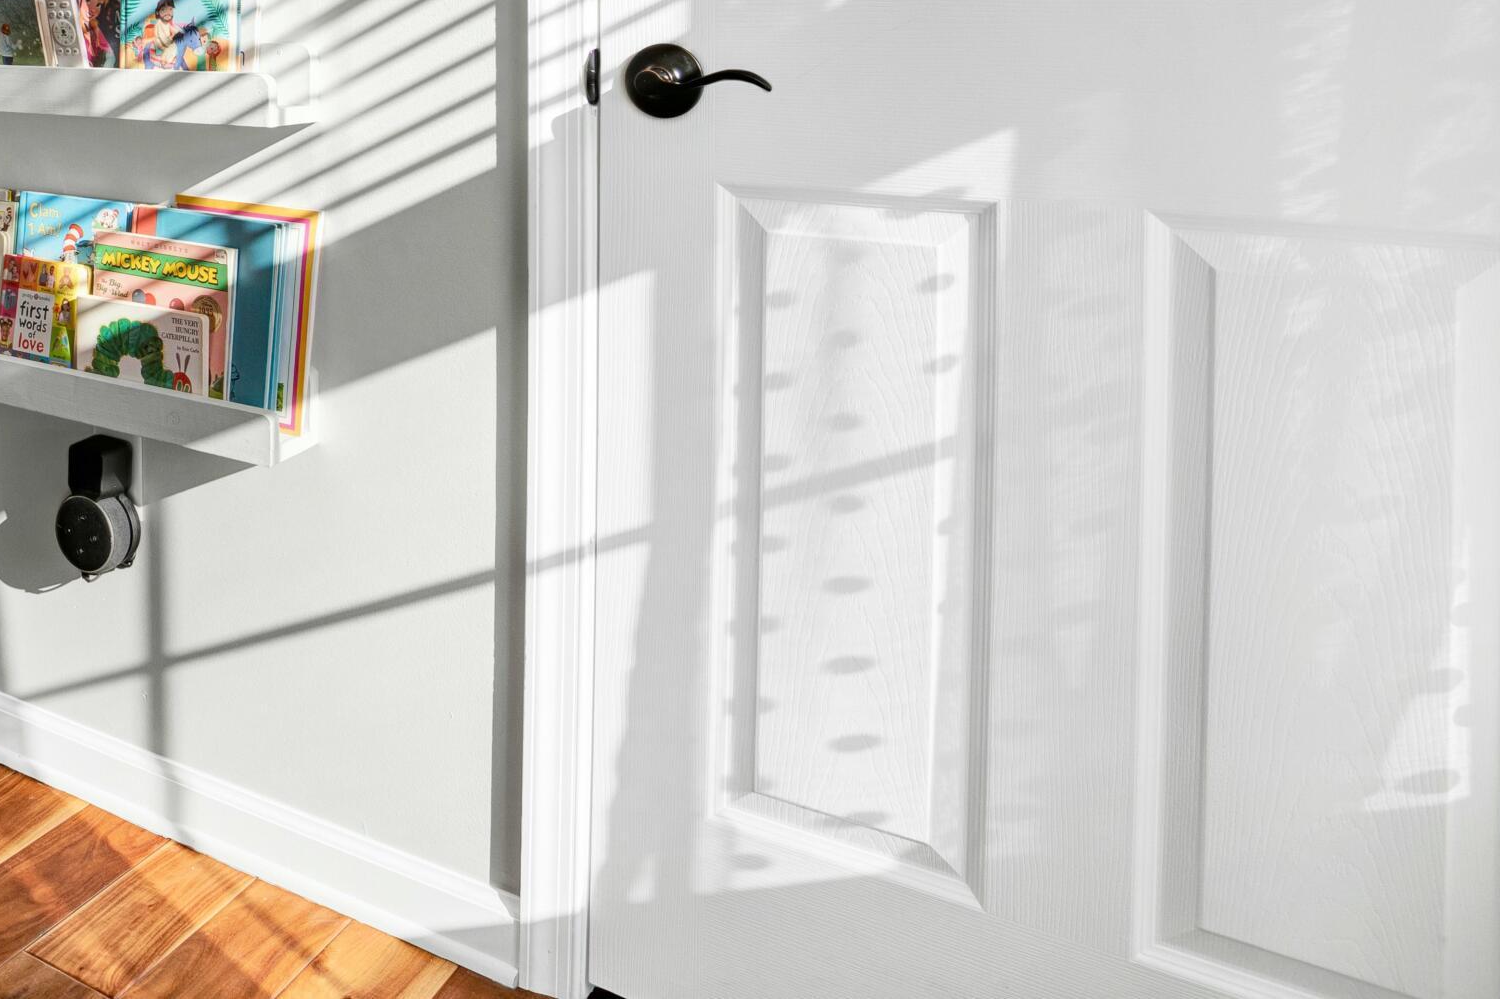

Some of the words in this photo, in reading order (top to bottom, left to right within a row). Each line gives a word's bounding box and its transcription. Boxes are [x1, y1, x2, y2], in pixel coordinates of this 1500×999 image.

[101, 249, 162, 275] MICKEY
[162, 261, 219, 285] MOUSE
[19, 300, 49, 321] first
[19, 317, 47, 333] words
[172, 317, 183, 326] THE
[184, 319, 200, 328] VERY
[28, 331, 36, 339] of
[161, 331, 200, 345] CATERPILLAR
[175, 326, 200, 337] HUNGRY
[18, 332, 45, 353] love
